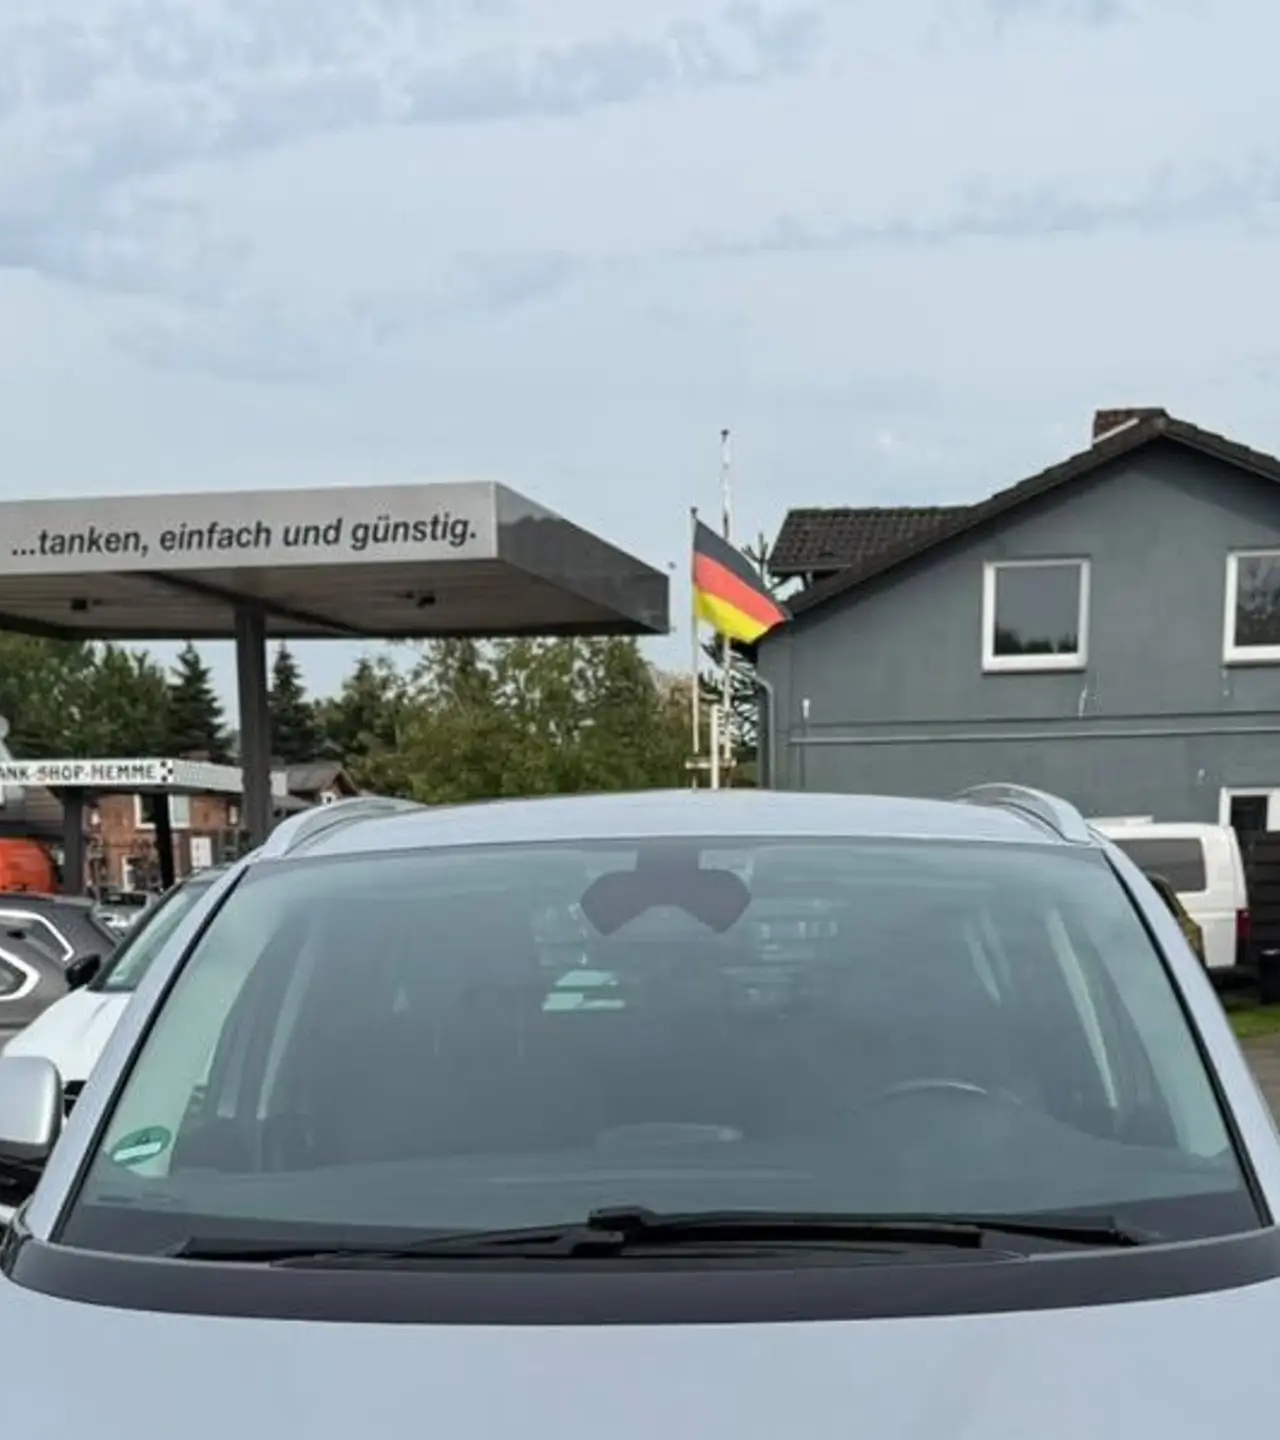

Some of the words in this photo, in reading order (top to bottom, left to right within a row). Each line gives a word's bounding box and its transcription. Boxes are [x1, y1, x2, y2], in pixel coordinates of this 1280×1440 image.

[11, 525, 149, 558] ...tanken,
[159, 520, 272, 551] einfach
[282, 517, 343, 547] und
[351, 511, 477, 554] günstig.
